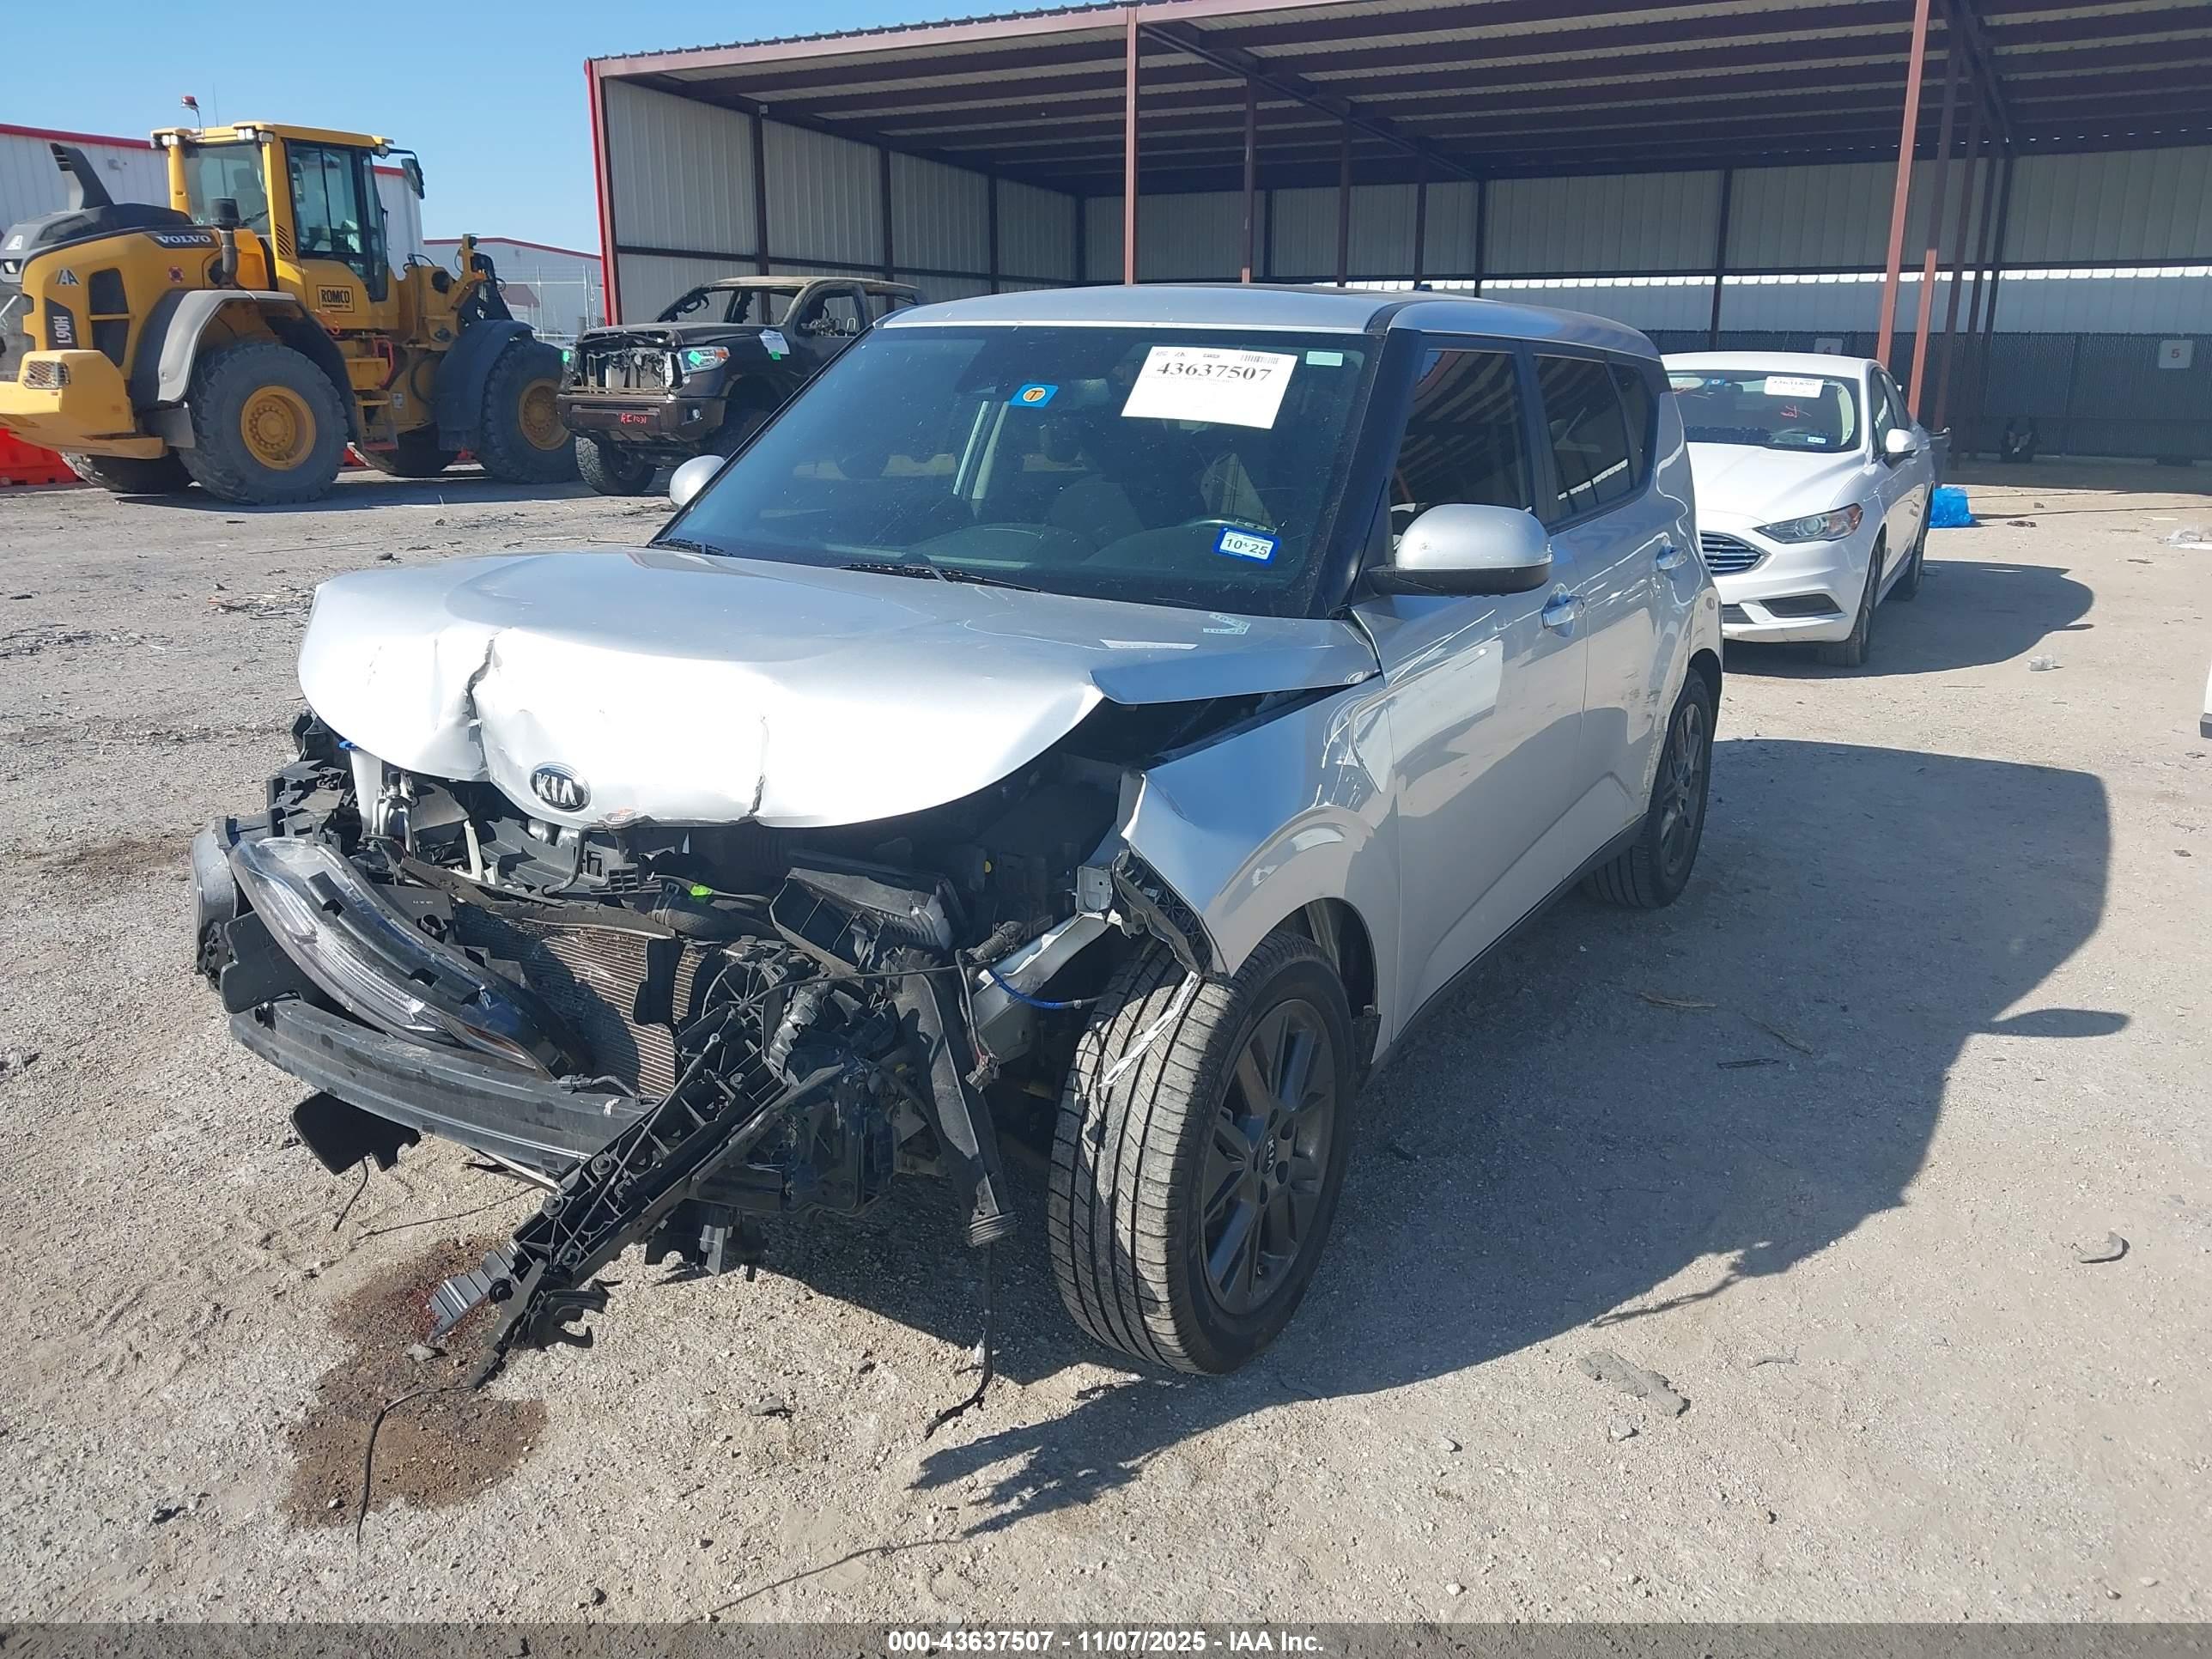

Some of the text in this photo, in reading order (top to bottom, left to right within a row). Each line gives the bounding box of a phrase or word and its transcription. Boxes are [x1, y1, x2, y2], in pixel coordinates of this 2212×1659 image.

[321, 289, 350, 303] ROMCO
[52, 315, 72, 343] L90H
[2171, 349, 2180, 358] 5
[1156, 362, 1273, 381] 43637507
[1226, 538, 1243, 550] 10
[1249, 544, 1269, 556] 25
[536, 772, 578, 805] KIA
[1267, 1138, 1275, 1171] KIA
